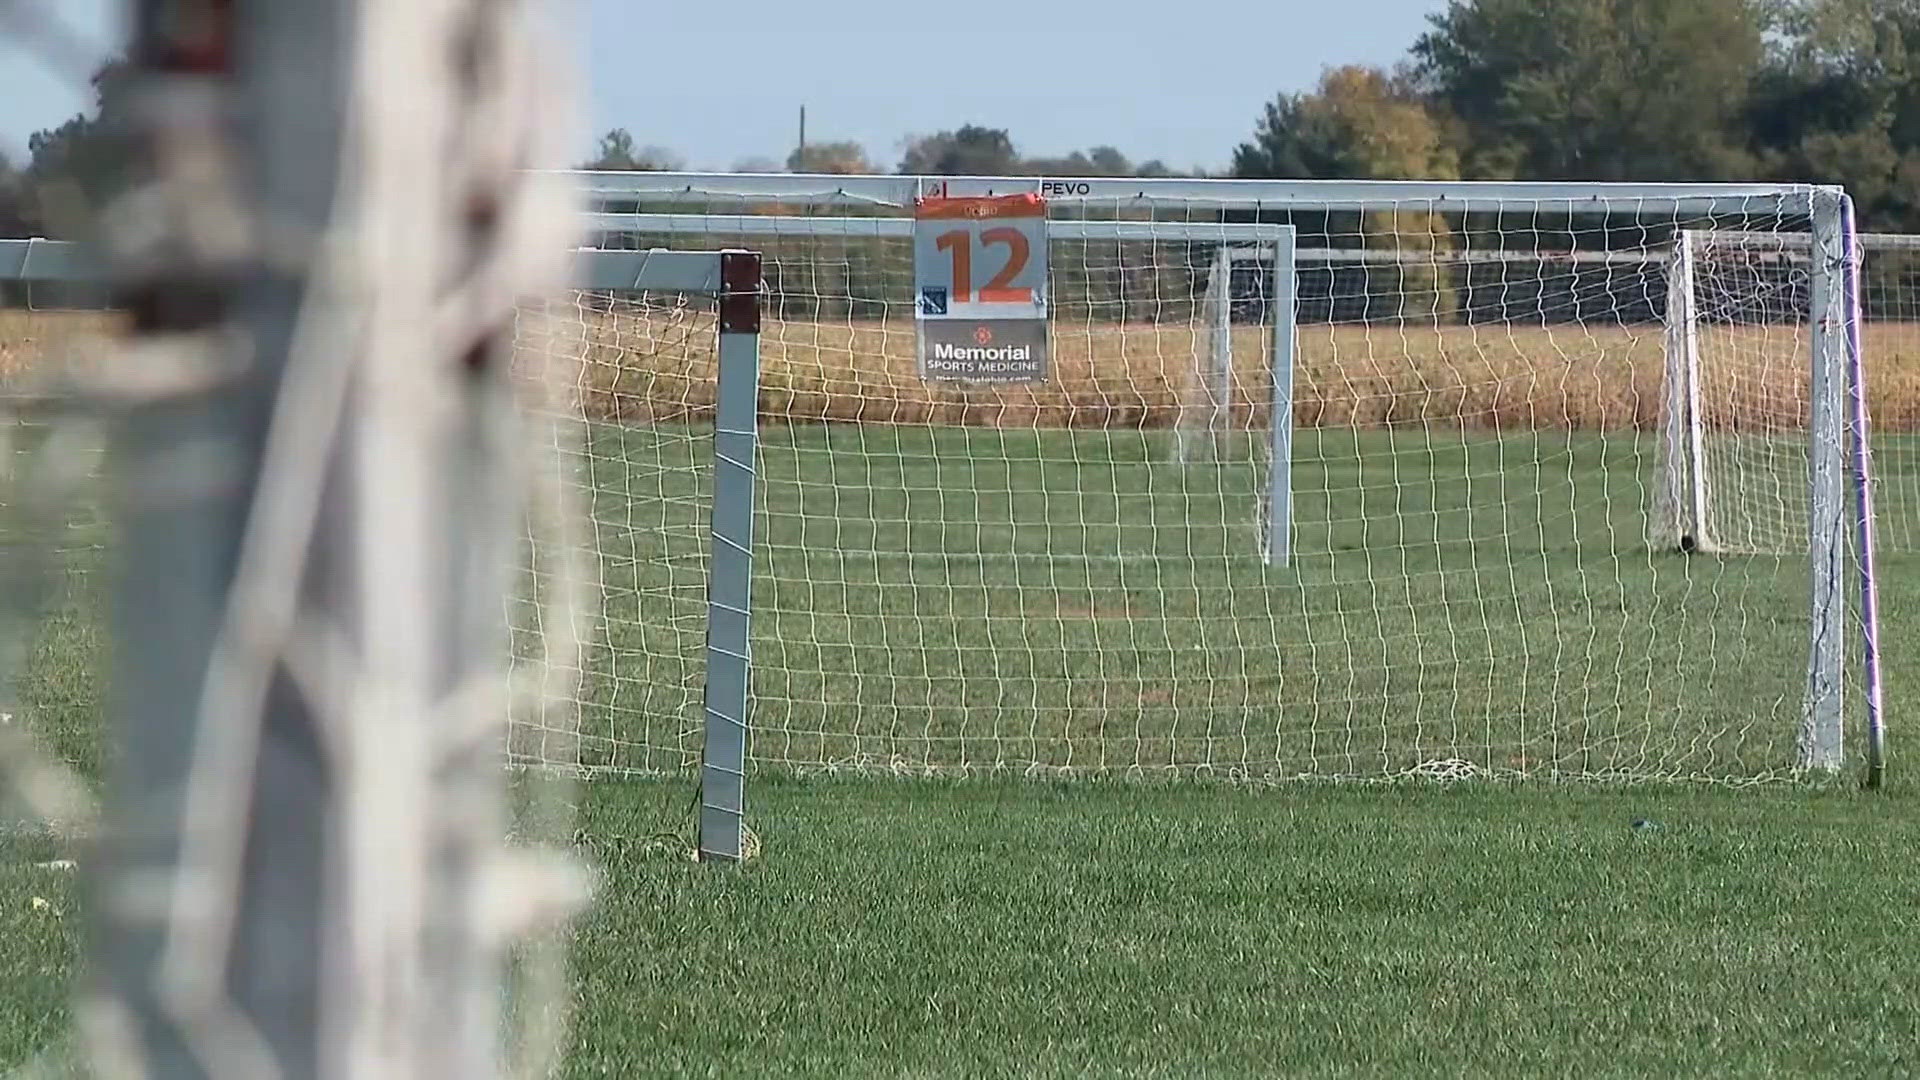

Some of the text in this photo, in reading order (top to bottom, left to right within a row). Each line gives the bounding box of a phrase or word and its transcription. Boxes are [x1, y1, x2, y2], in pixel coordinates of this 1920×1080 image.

[1042, 183, 1090, 195] PEVO
[936, 227, 1032, 303] 12
[935, 344, 1030, 360] Memorial
[927, 360, 1039, 372] SPORTS MEDICINE
